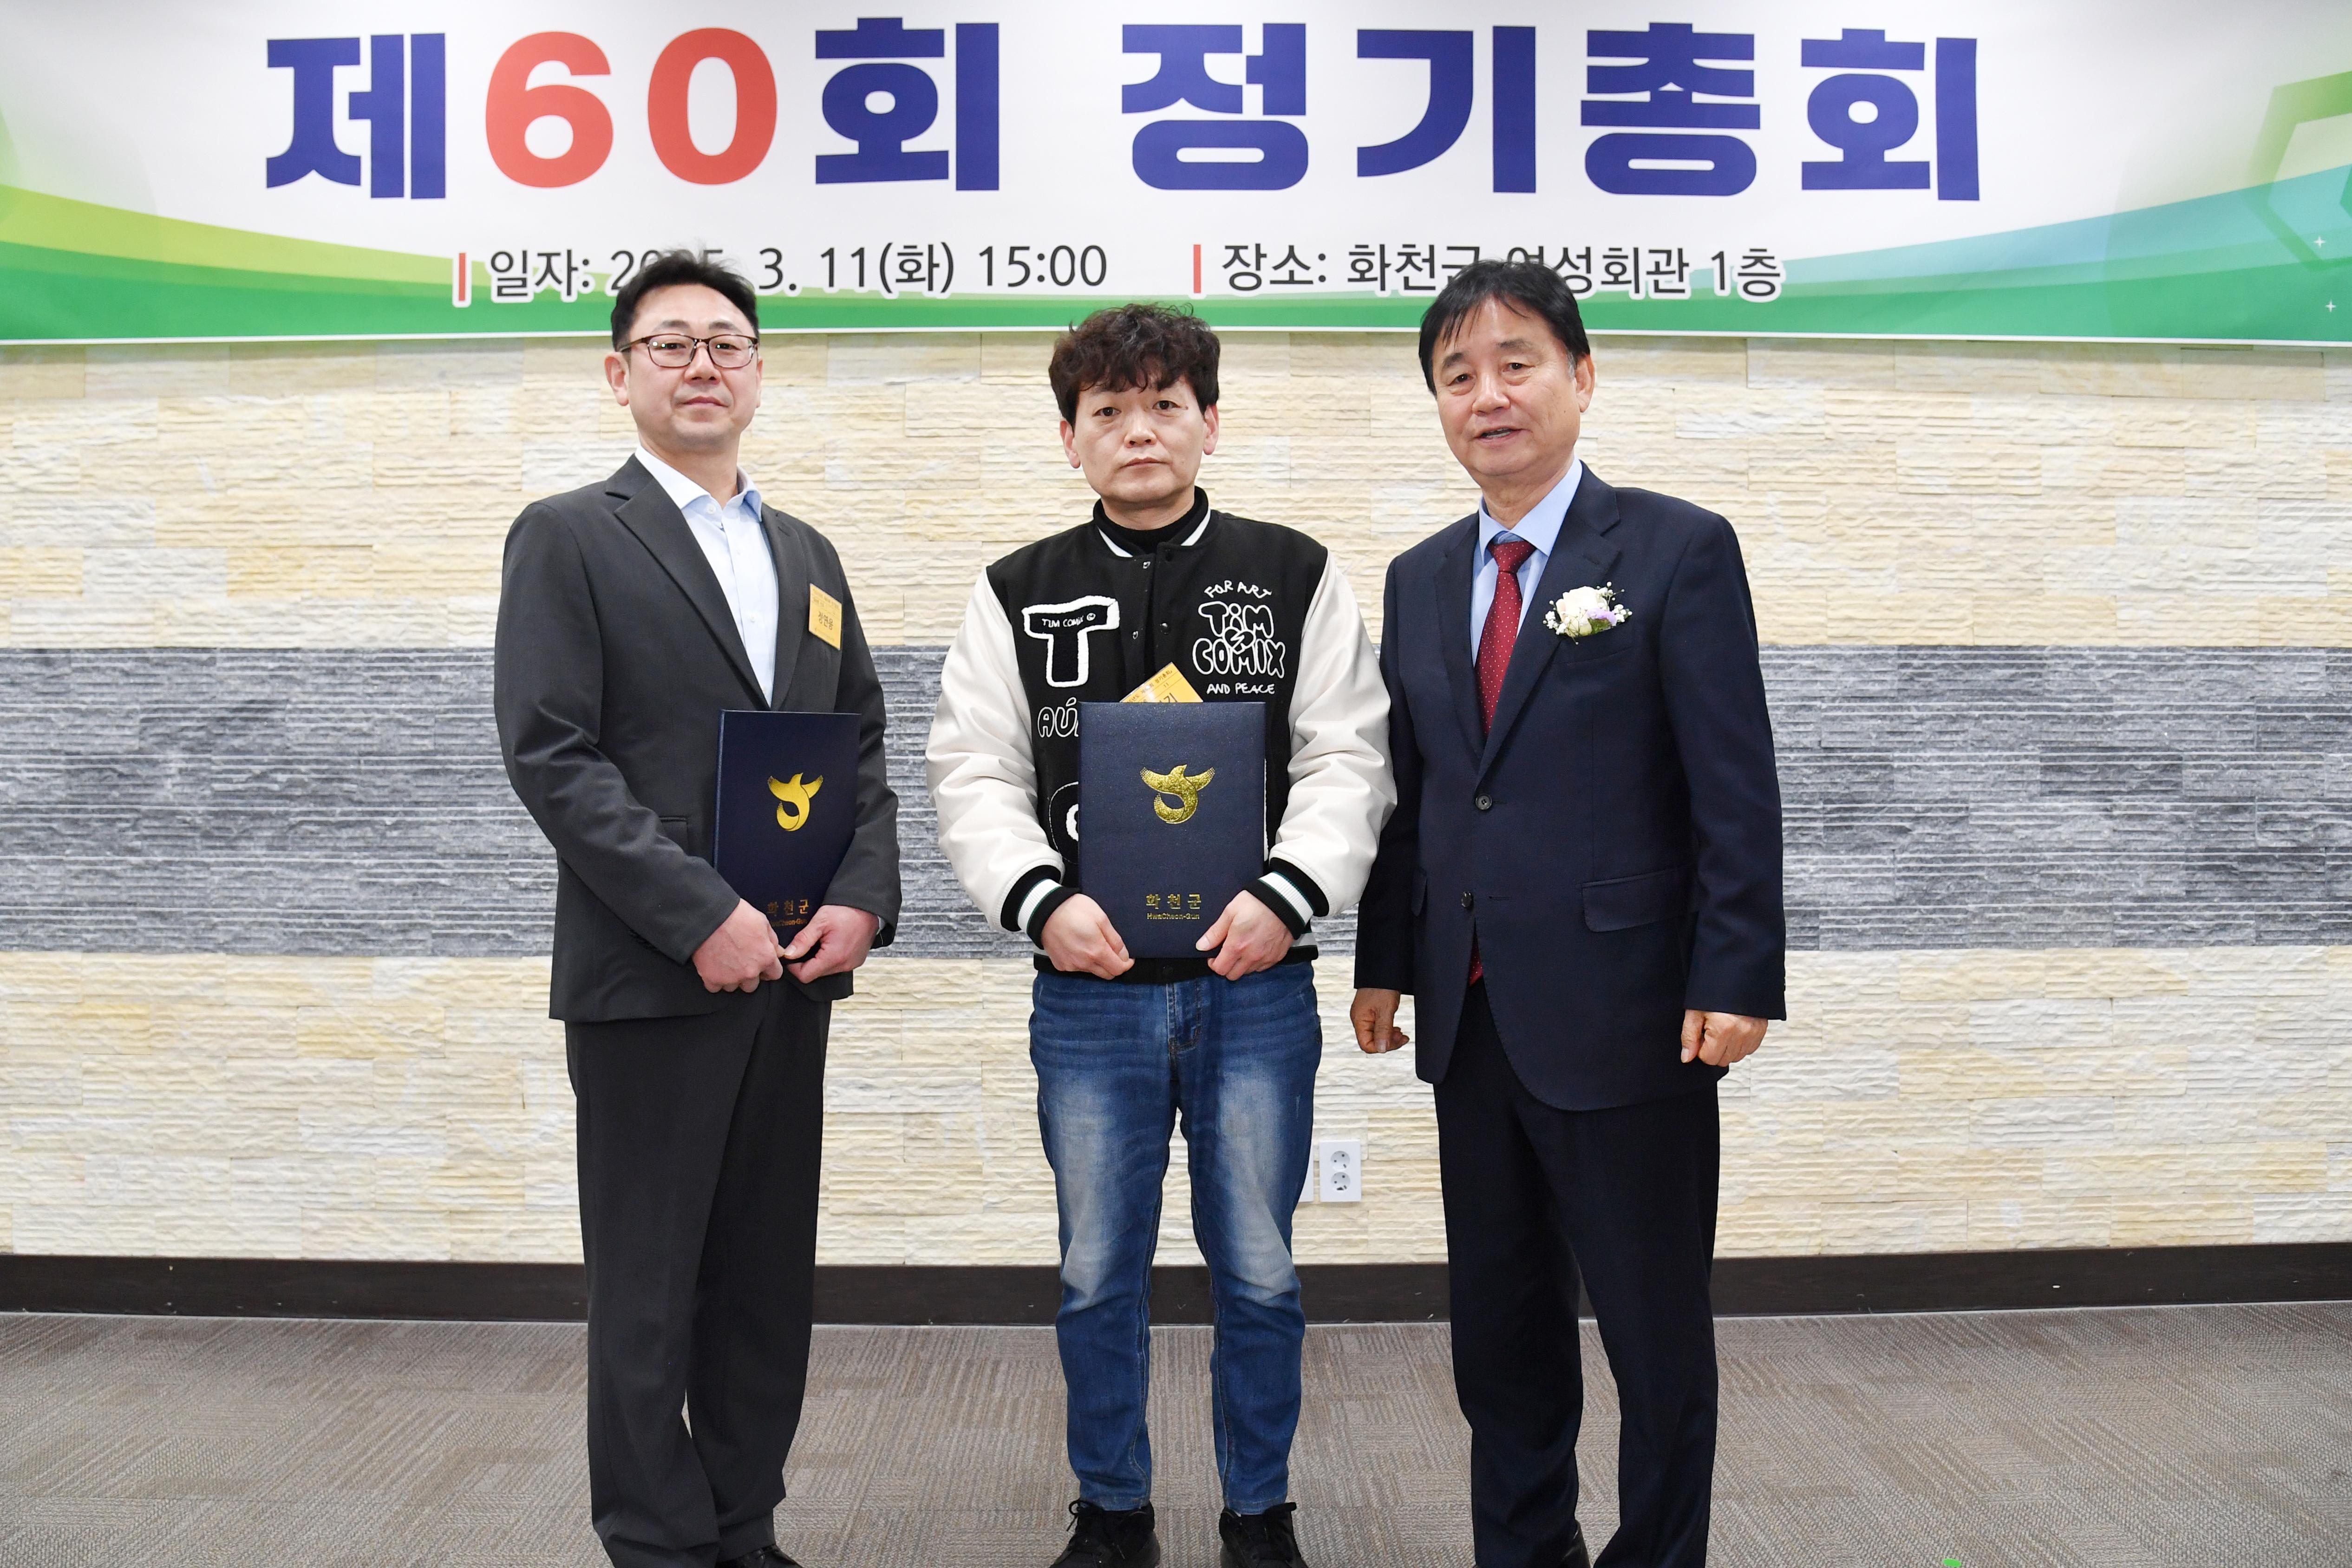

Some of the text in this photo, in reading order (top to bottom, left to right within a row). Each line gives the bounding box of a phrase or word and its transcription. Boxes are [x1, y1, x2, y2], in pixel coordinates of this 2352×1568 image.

[268, 18, 1979, 200] 제60회 정기총회
[491, 249, 589, 296] 일자:
[759, 248, 796, 291] 3.
[821, 242, 954, 294] 11(화)
[979, 245, 1106, 287] 15:00
[1222, 243, 1326, 291] 장소:
[1712, 248, 1780, 296] 1층
[1204, 580, 1272, 598] FOR ART
[1192, 638, 1286, 678] COMIX
[1207, 683, 1275, 694] AND PEACE
